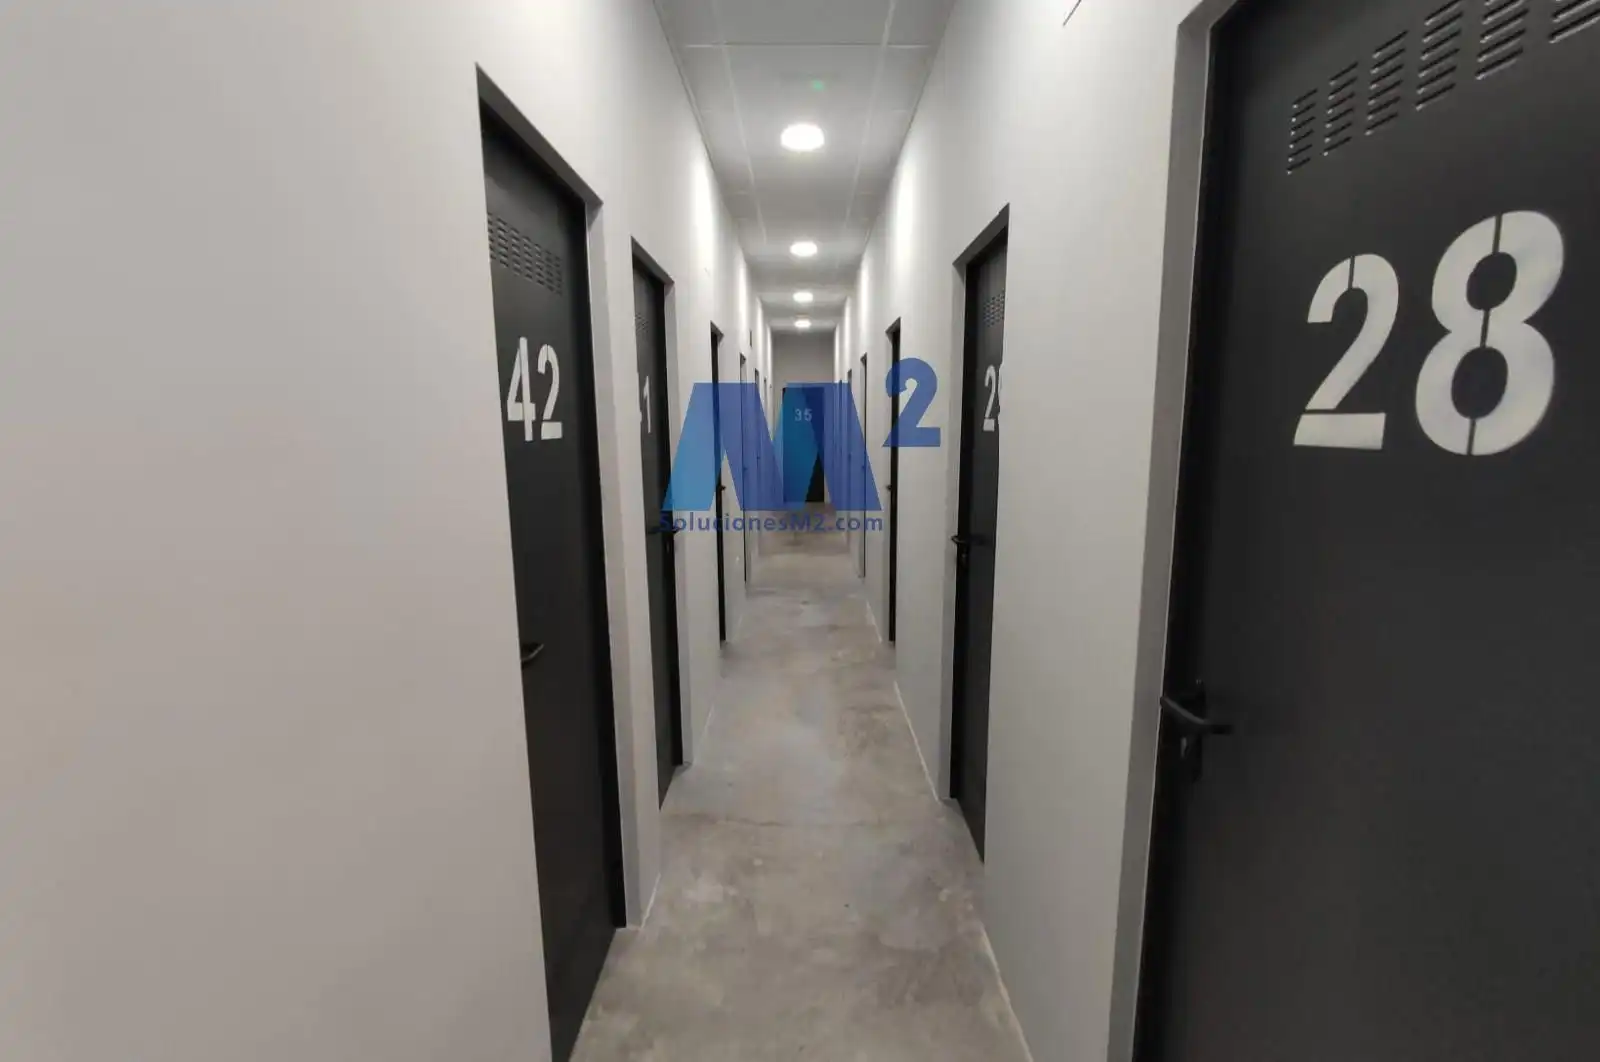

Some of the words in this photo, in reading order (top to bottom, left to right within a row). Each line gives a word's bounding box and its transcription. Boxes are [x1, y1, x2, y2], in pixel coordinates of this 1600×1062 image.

[1294, 210, 1564, 456] 28
[506, 336, 563, 441] 42
[794, 408, 812, 421] 35
[983, 364, 1001, 431] 2
